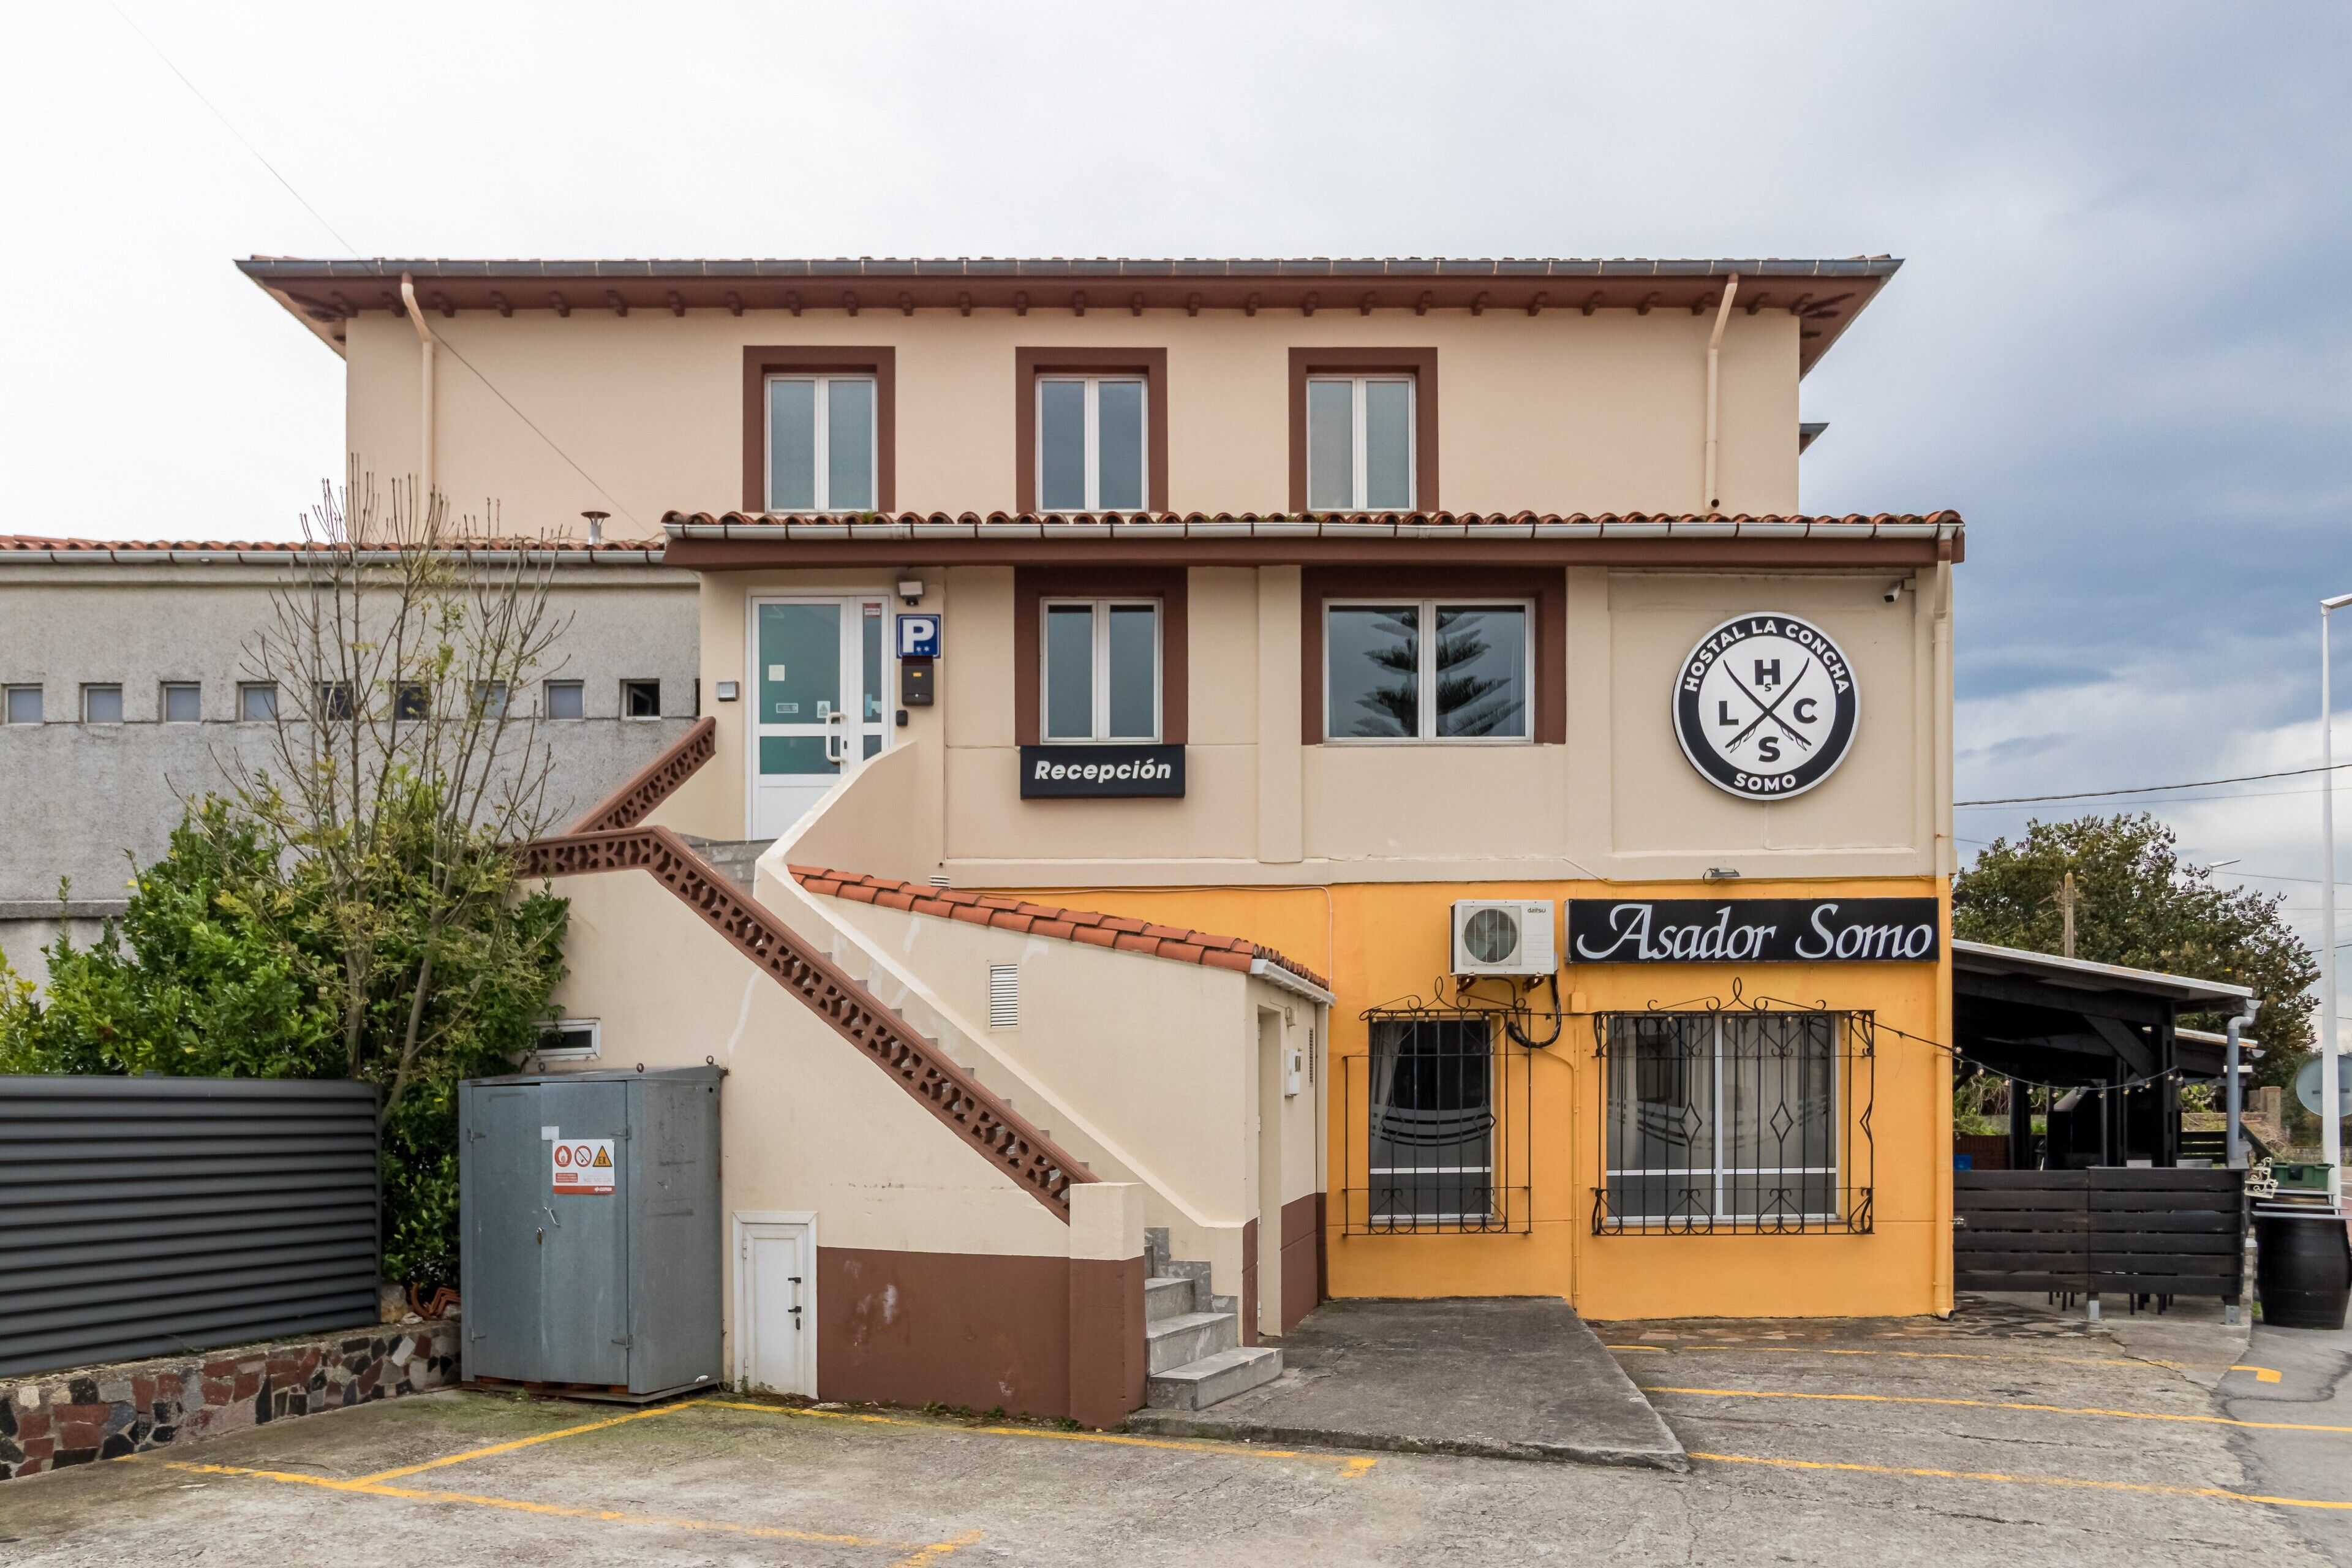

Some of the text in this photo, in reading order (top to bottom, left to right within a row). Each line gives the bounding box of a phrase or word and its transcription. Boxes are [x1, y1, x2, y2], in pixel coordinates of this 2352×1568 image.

[903, 619, 934, 652] P
[1684, 620, 1850, 694] HOSTAL LA CONCHA
[1754, 659, 1781, 685] H
[1719, 698, 1818, 726] L C
[1758, 736, 1781, 763] S
[1035, 758, 1171, 783] Recepción
[1734, 773, 1796, 791] SOMO
[1577, 903, 1932, 959] Asador Somo
